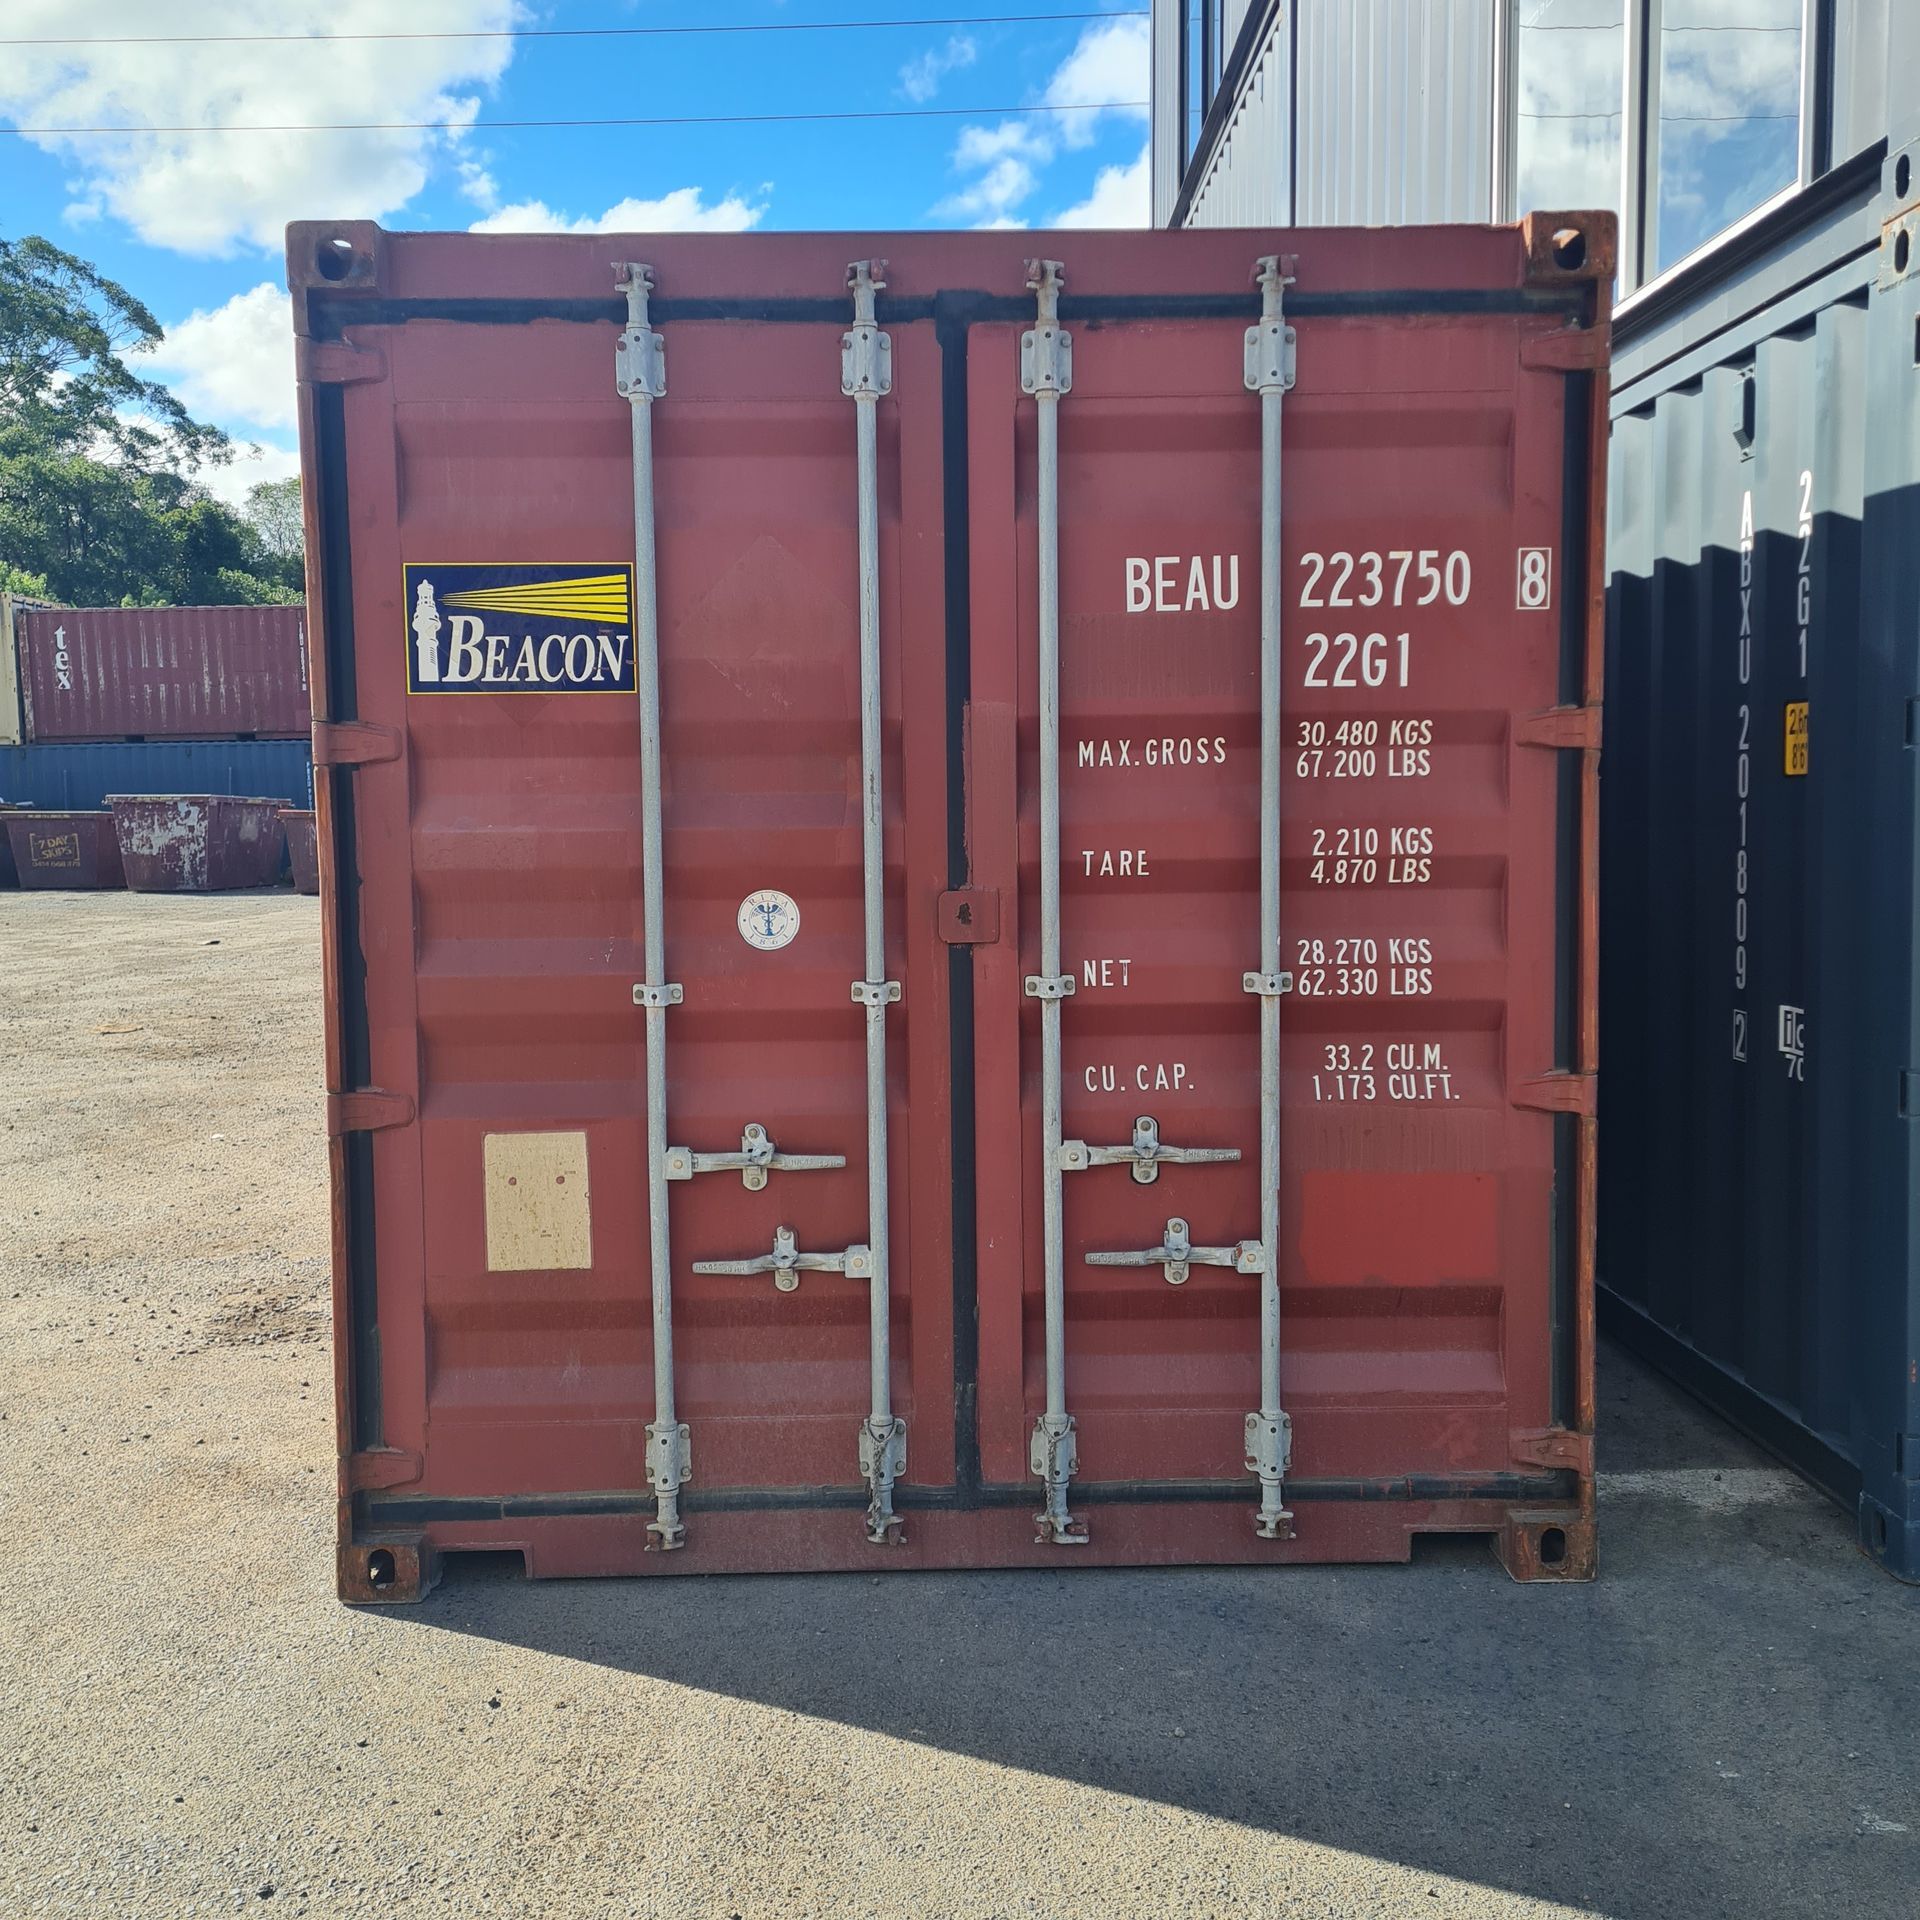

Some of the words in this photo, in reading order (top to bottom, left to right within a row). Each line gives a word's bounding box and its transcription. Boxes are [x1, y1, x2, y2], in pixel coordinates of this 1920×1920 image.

[1126, 555, 1238, 612] BEAU
[1300, 551, 1470, 607] 223750
[1520, 552, 1546, 606] 8
[1739, 490, 1754, 685] ABXU
[1797, 470, 1813, 678] 22G1
[54, 625, 71, 690] tex
[440, 615, 629, 683] BEACON
[1304, 633, 1409, 686] 22G1
[1080, 738, 1225, 767] MAX.GROSS
[1390, 720, 1432, 745] KGS
[1389, 749, 1430, 776] LBS
[41, 846, 73, 859] SKIPS
[47, 836, 68, 848] DAY
[1392, 828, 1433, 854] KGS
[1736, 704, 1750, 990] 201809
[1083, 850, 1149, 875] TARE
[1389, 859, 1431, 882] LBS
[748, 894, 789, 908] RINA
[1389, 939, 1432, 963] KGS
[1084, 960, 1131, 986] NET
[1391, 968, 1432, 994] LBS
[1735, 1012, 1746, 1059] 2
[1325, 1045, 1373, 1070] 33.2
[1387, 1044, 1447, 1070] CU.M.
[1086, 1066, 1125, 1091] CU.
[1137, 1064, 1193, 1090] CAP.
[1389, 1074, 1459, 1099] CU.FT.
